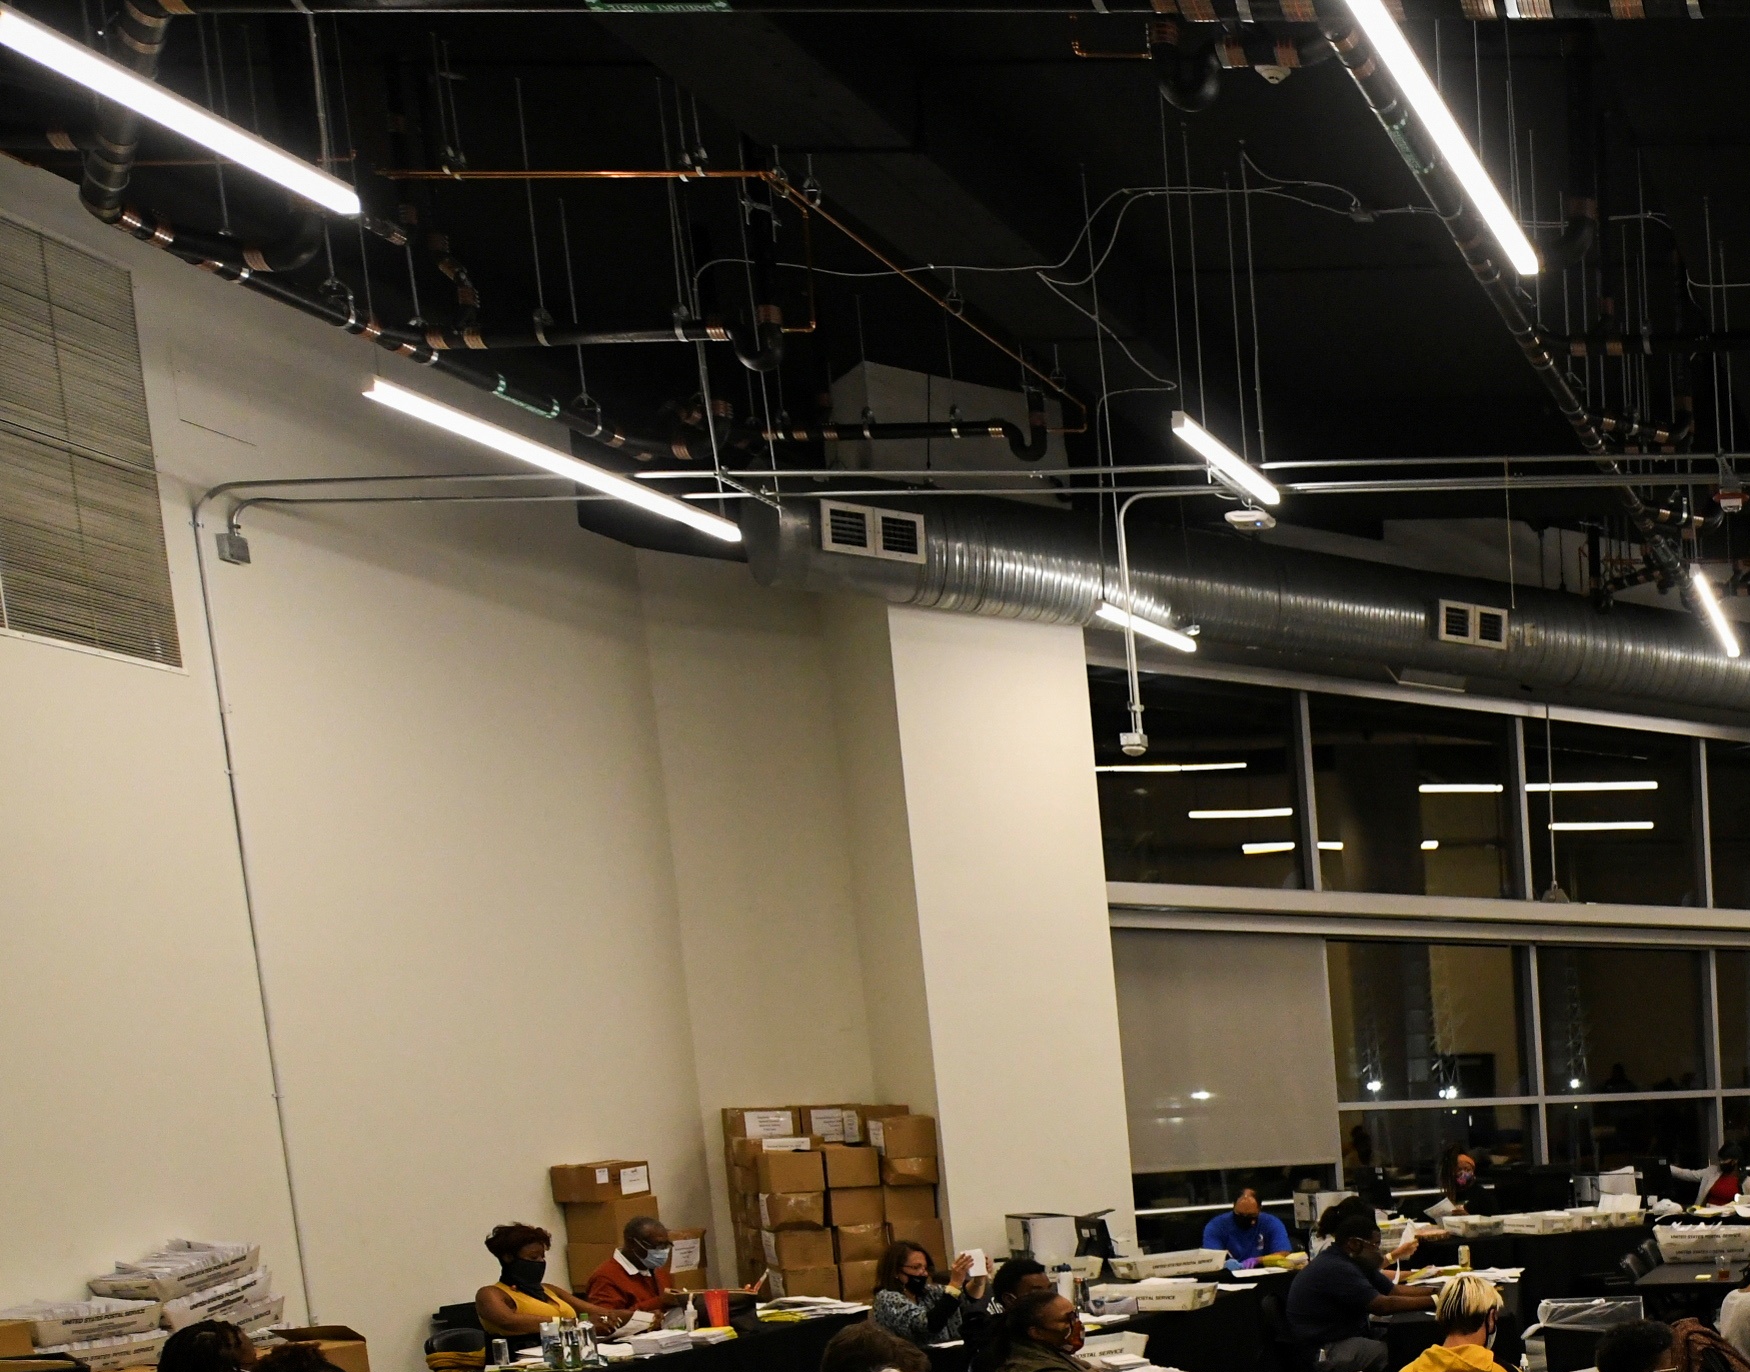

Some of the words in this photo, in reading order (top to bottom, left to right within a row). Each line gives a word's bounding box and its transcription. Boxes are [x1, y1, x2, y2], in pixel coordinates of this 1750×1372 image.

[657, 3, 716, 12] SANITARY
[62, 1316, 83, 1325] UNITED
[84, 1315, 104, 1323] STATES
[104, 1312, 123, 1320] POSTAL
[124, 1308, 145, 1317] SERVICE
[1099, 1347, 1125, 1357] SERVICE
